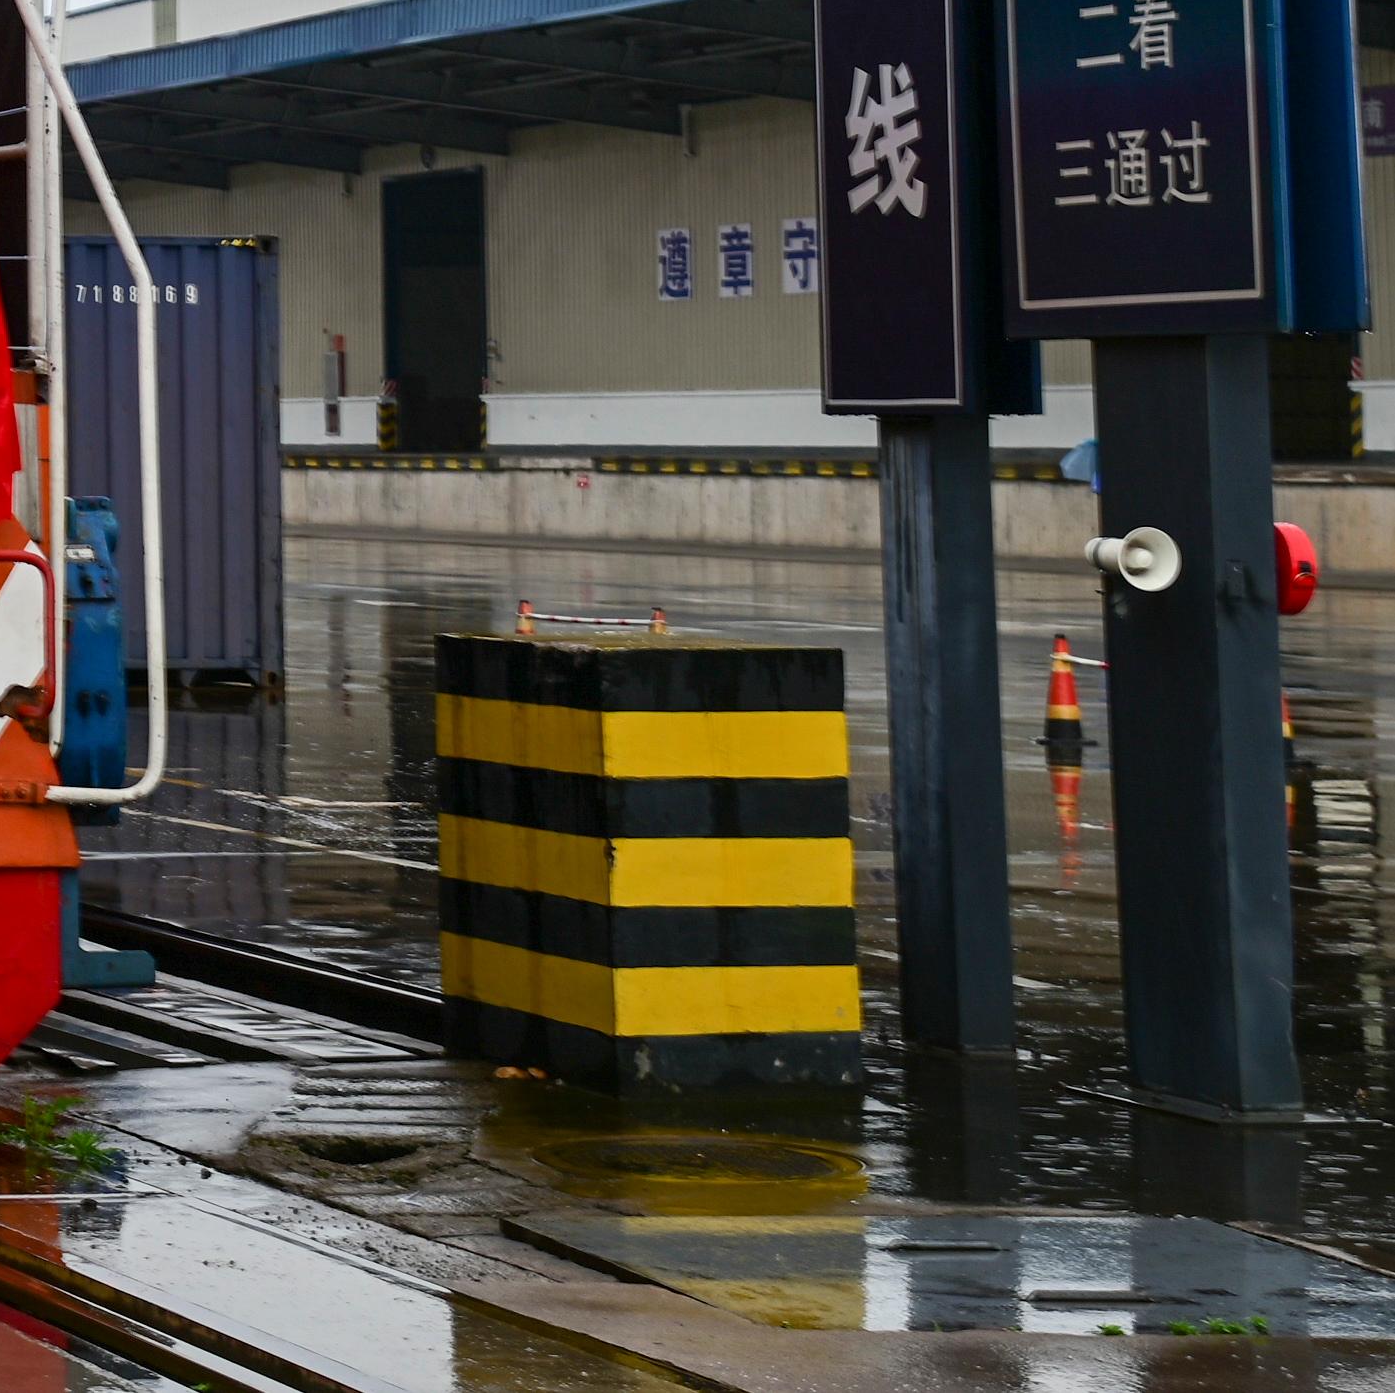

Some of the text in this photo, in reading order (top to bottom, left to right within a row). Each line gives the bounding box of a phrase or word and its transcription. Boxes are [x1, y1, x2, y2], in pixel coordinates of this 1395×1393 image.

[845, 62, 928, 218] 线
[1055, 120, 1212, 206] 三通过
[659, 221, 817, 298] 遵章守
